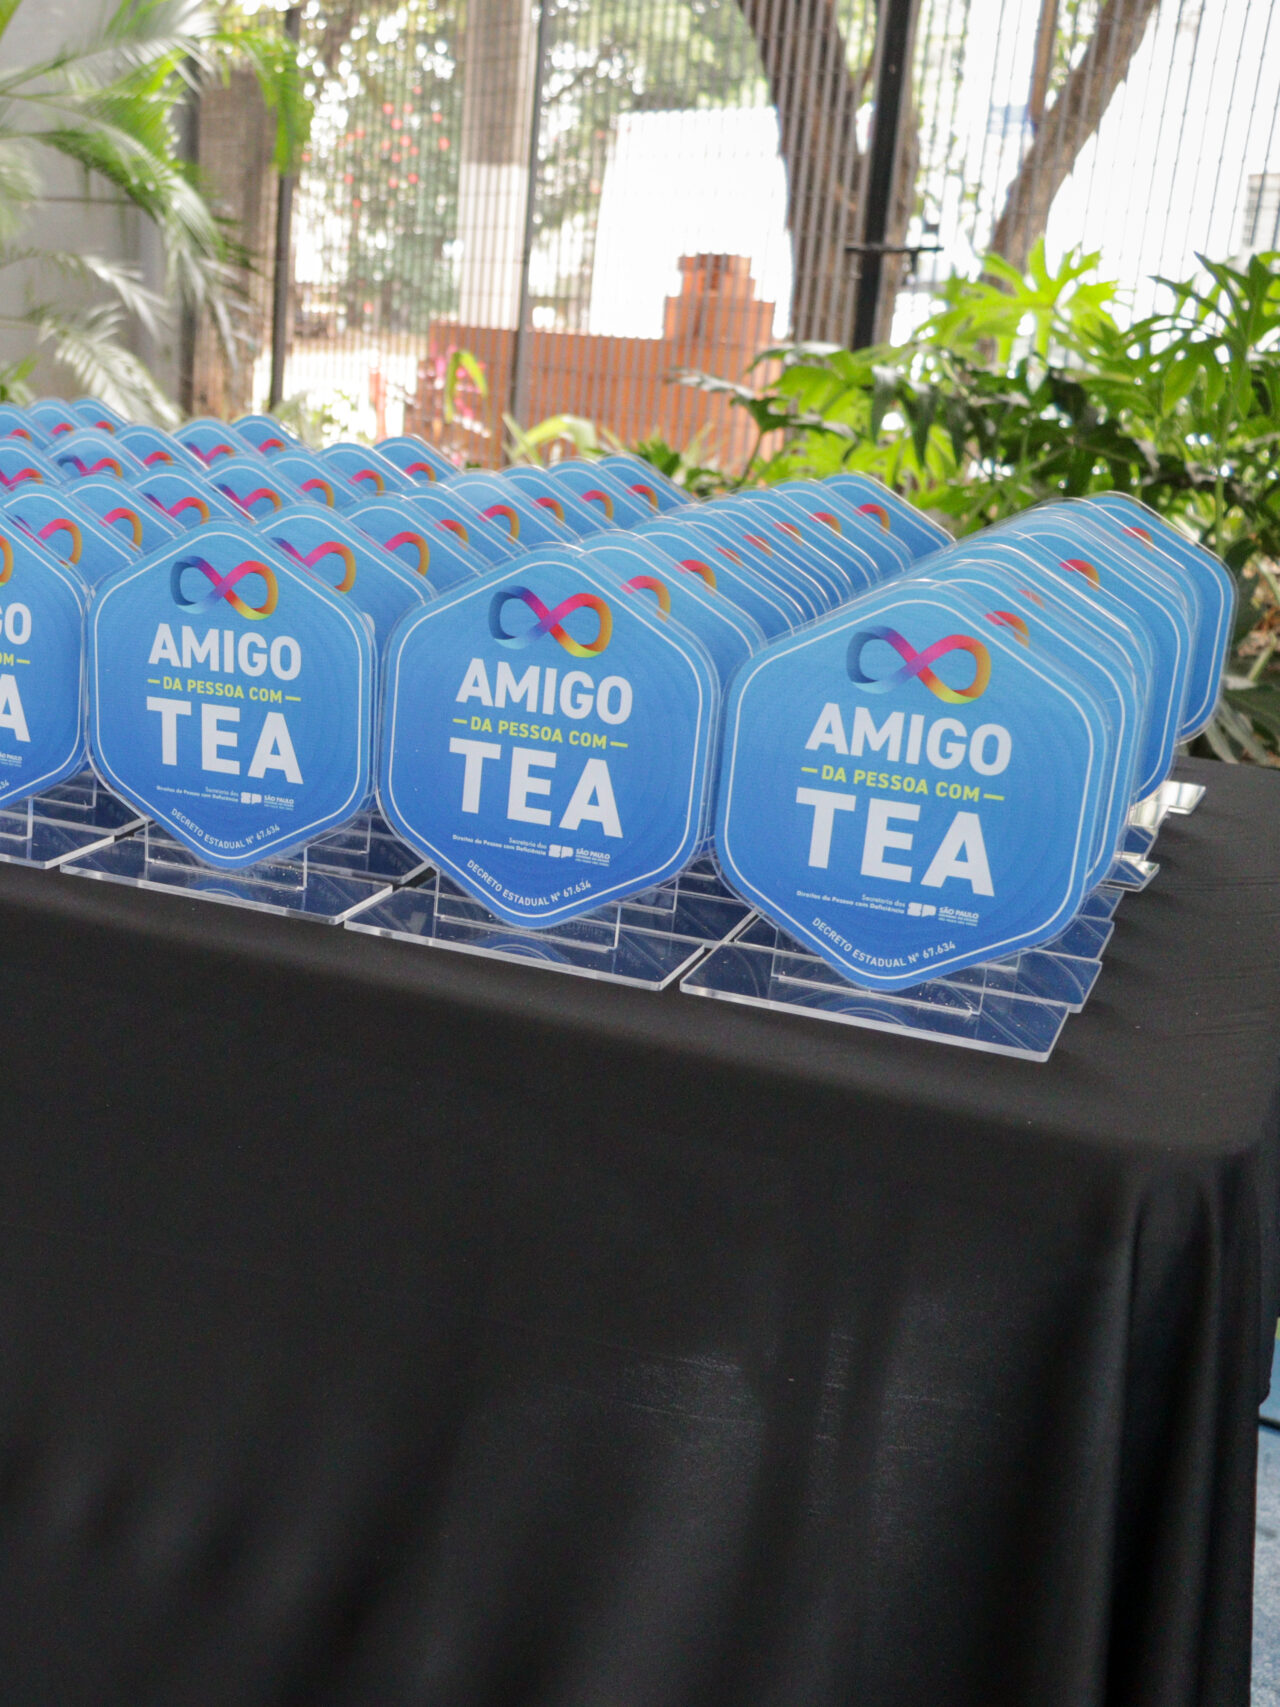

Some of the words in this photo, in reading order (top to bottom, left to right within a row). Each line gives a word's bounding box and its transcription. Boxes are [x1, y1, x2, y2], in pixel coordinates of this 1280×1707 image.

[148, 623, 302, 681] AMIGO
[163, 676, 183, 692] DA
[187, 680, 245, 699] PESSOA
[249, 686, 282, 703] COM
[455, 657, 633, 725] AMIGO
[146, 695, 304, 785] TEA
[470, 716, 493, 733] DA
[498, 720, 563, 744] PESSOA
[569, 731, 607, 750] COM
[805, 702, 1013, 776] AMIGO
[449, 737, 623, 838] TEA
[821, 765, 847, 783] DA
[853, 770, 929, 796] PESSOA
[935, 781, 980, 802] COM
[171, 808, 203, 837] DECRETO
[204, 834, 245, 849] ESTADUAL
[795, 786, 995, 897] TEA
[467, 860, 502, 892] DECRETO
[502, 889, 549, 906] ESTADUAL
[563, 880, 591, 898] 67.634
[939, 906, 954, 915] SÃO
[956, 910, 979, 919] PAULO
[812, 918, 852, 952] DECRETO
[852, 949, 906, 968] ESTADUAL
[923, 941, 956, 959] 67.634
